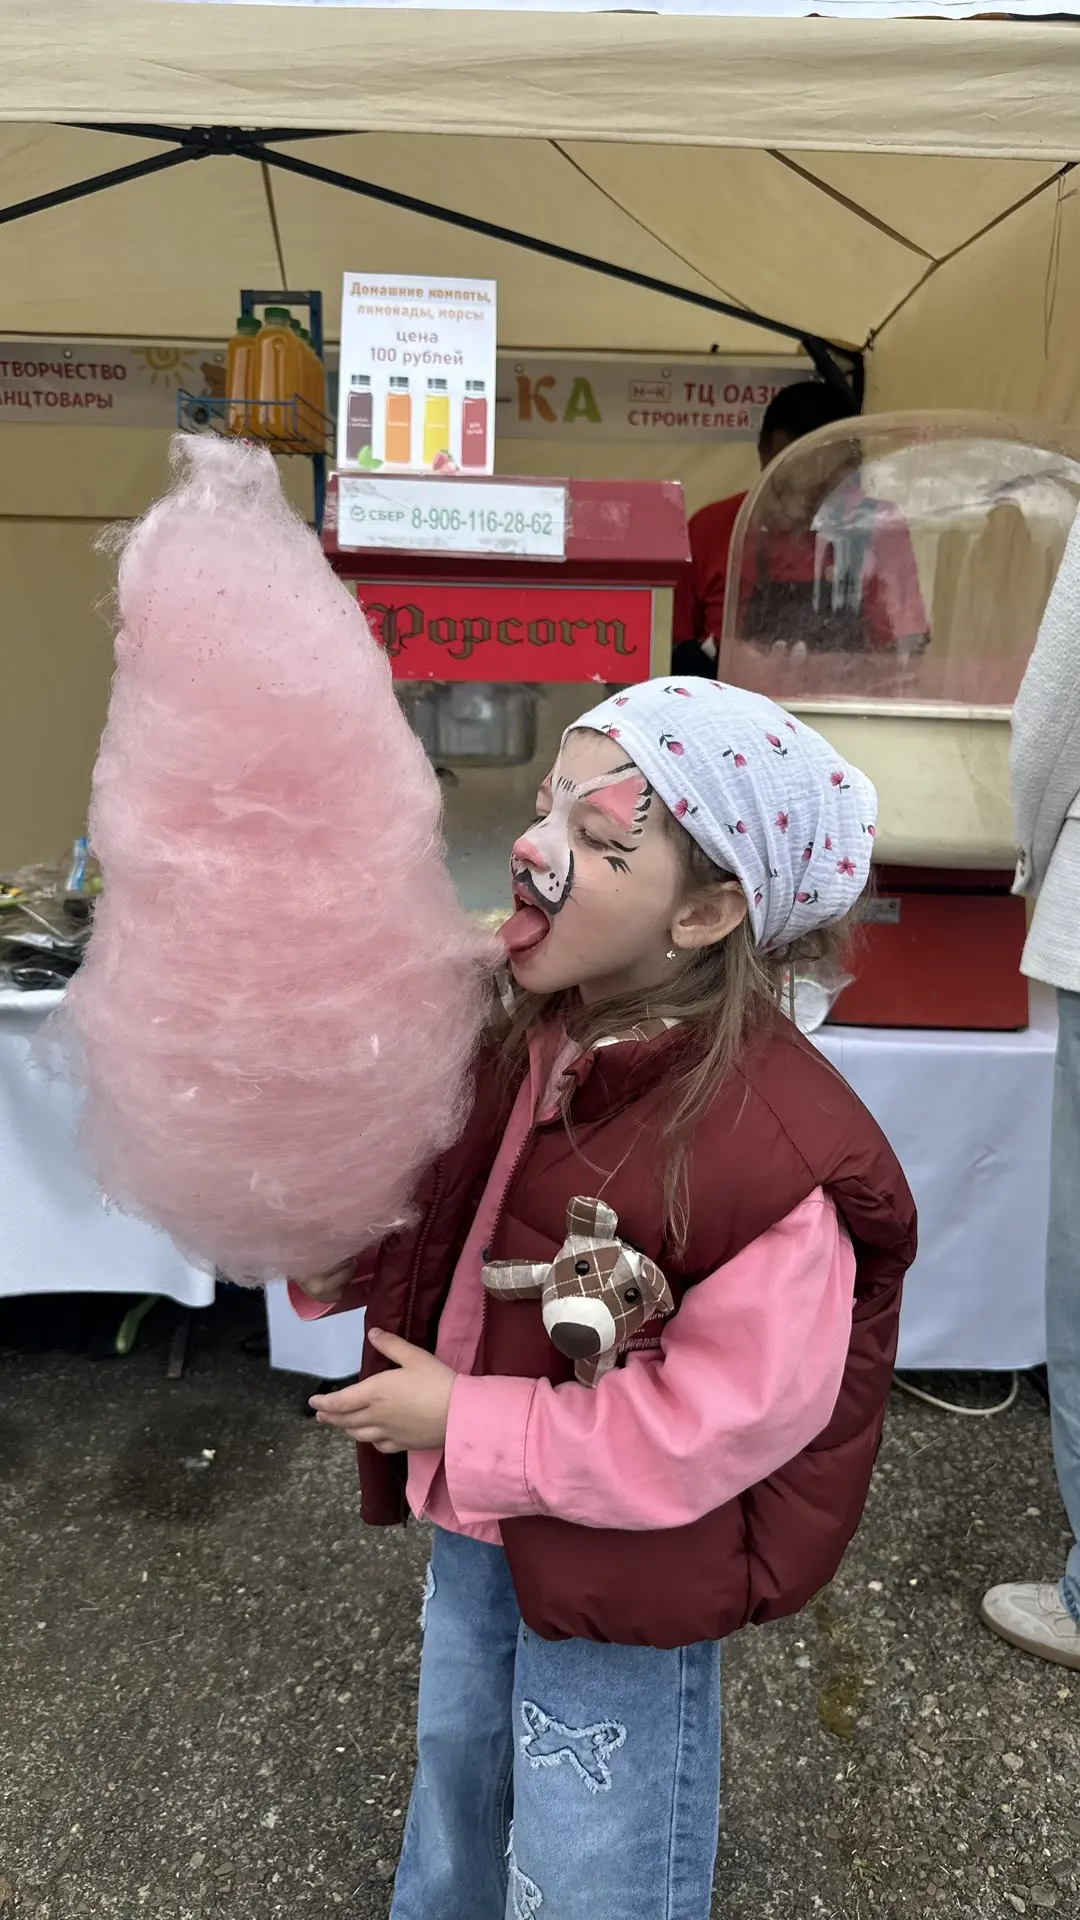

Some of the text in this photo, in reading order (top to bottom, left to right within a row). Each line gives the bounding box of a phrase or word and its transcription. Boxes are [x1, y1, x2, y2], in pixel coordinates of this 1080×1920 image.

[350, 282, 491, 303] Домашние компоты,
[357, 304, 484, 322] лимонады, морсы
[396, 331, 439, 343] цена
[370, 347, 464, 366] 100 рублей
[0, 361, 127, 380] ТВОРЧЕСТВО
[0, 390, 114, 409] НЦТОВАРЫ
[683, 382, 716, 407] ТЦ
[368, 507, 553, 536] СБЕР 8-906-116-28-62
[366, 603, 637, 660] Popcorn
